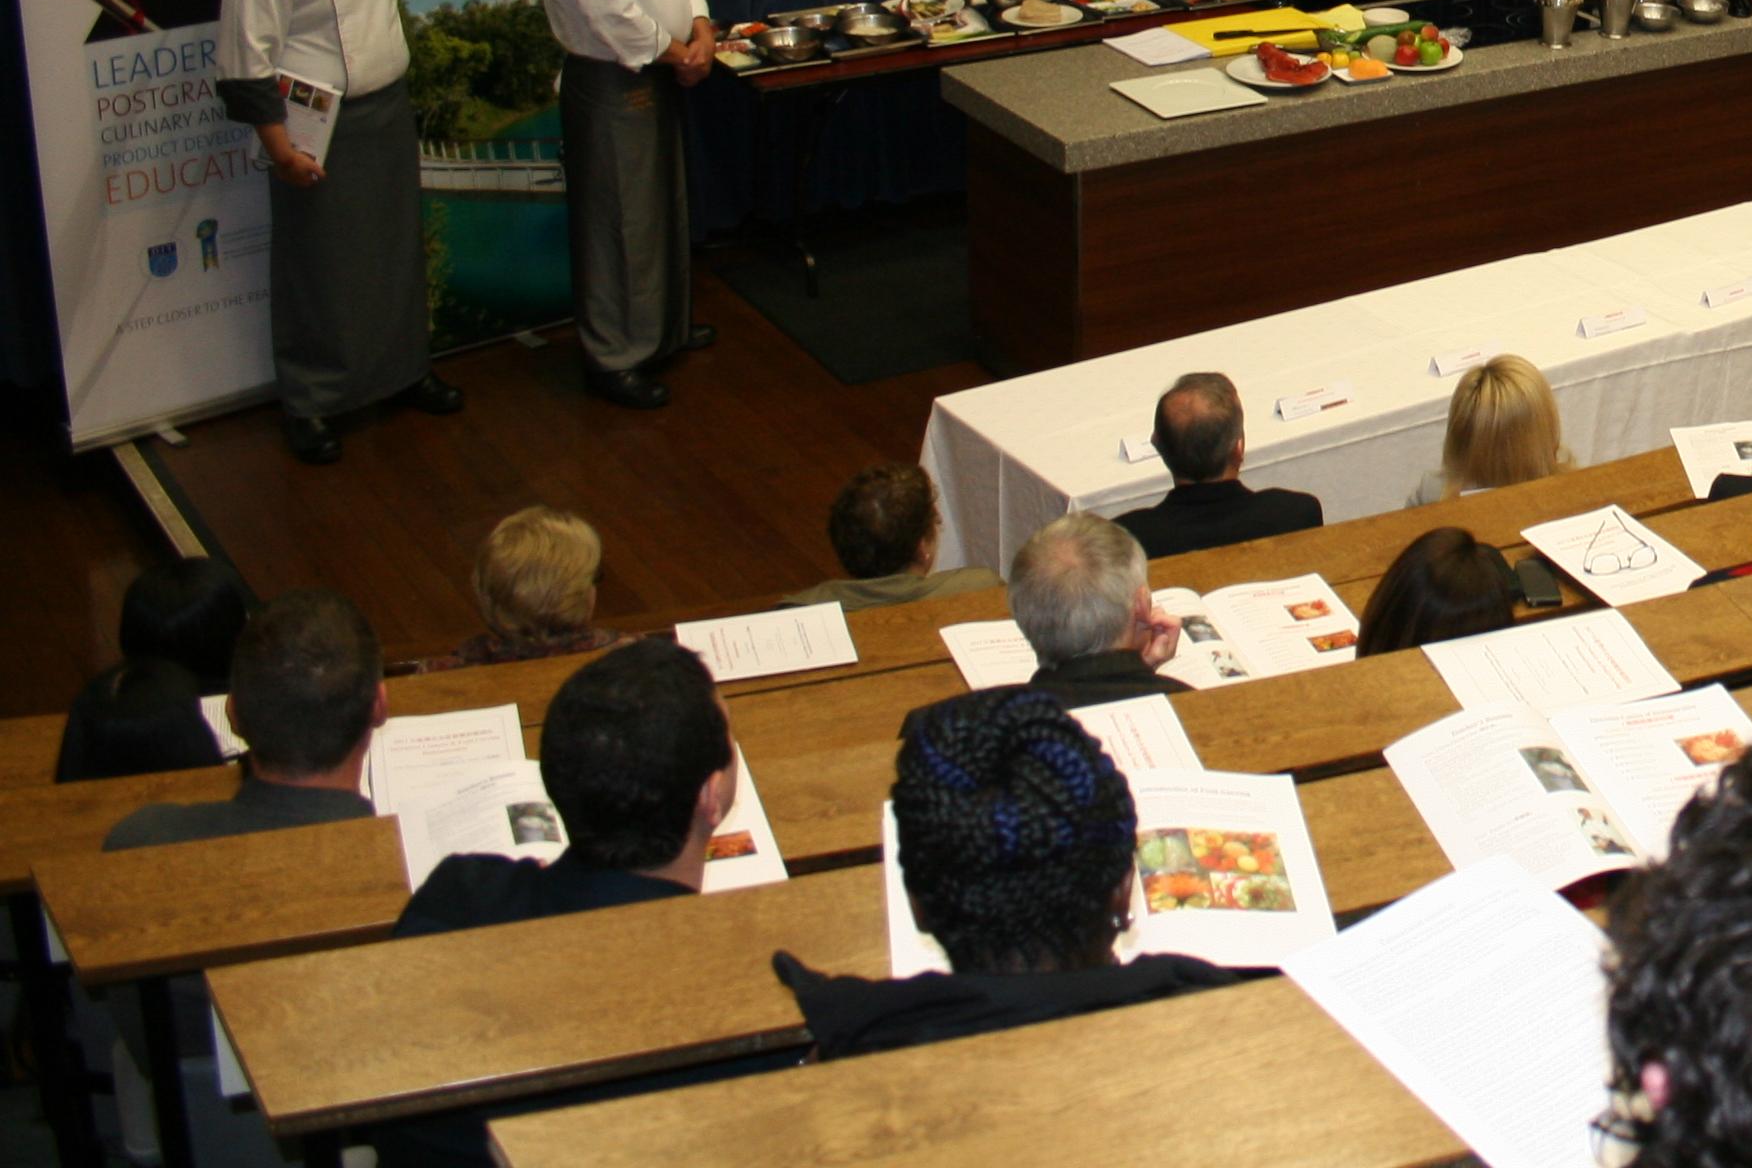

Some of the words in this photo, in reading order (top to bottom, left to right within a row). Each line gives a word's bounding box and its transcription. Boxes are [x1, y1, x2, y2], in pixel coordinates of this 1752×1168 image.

[93, 39, 217, 89] LEADER
[97, 79, 216, 121] POSTGRA
[101, 111, 193, 145] CULINARY
[199, 105, 226, 124] AN
[103, 139, 179, 168] PRODUCT
